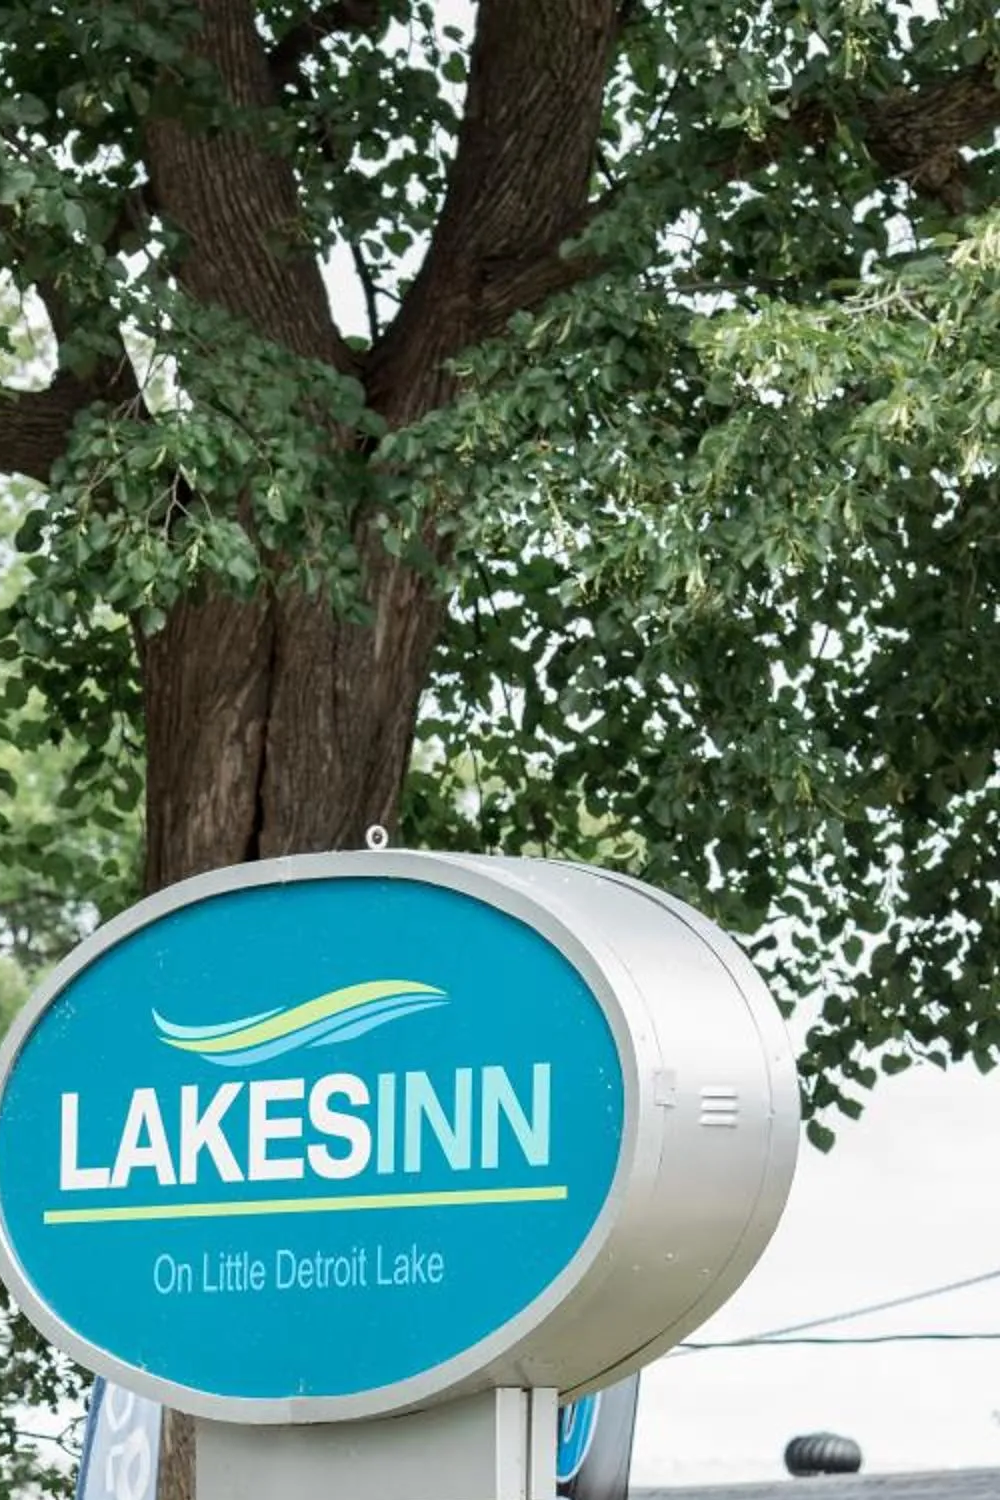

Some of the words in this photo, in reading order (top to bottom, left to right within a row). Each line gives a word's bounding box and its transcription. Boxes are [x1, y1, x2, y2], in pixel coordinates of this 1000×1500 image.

[153, 1253, 193, 1294] On
[203, 1251, 266, 1293] Little
[276, 1247, 367, 1290] Detroit
[377, 1244, 444, 1285] Lake
